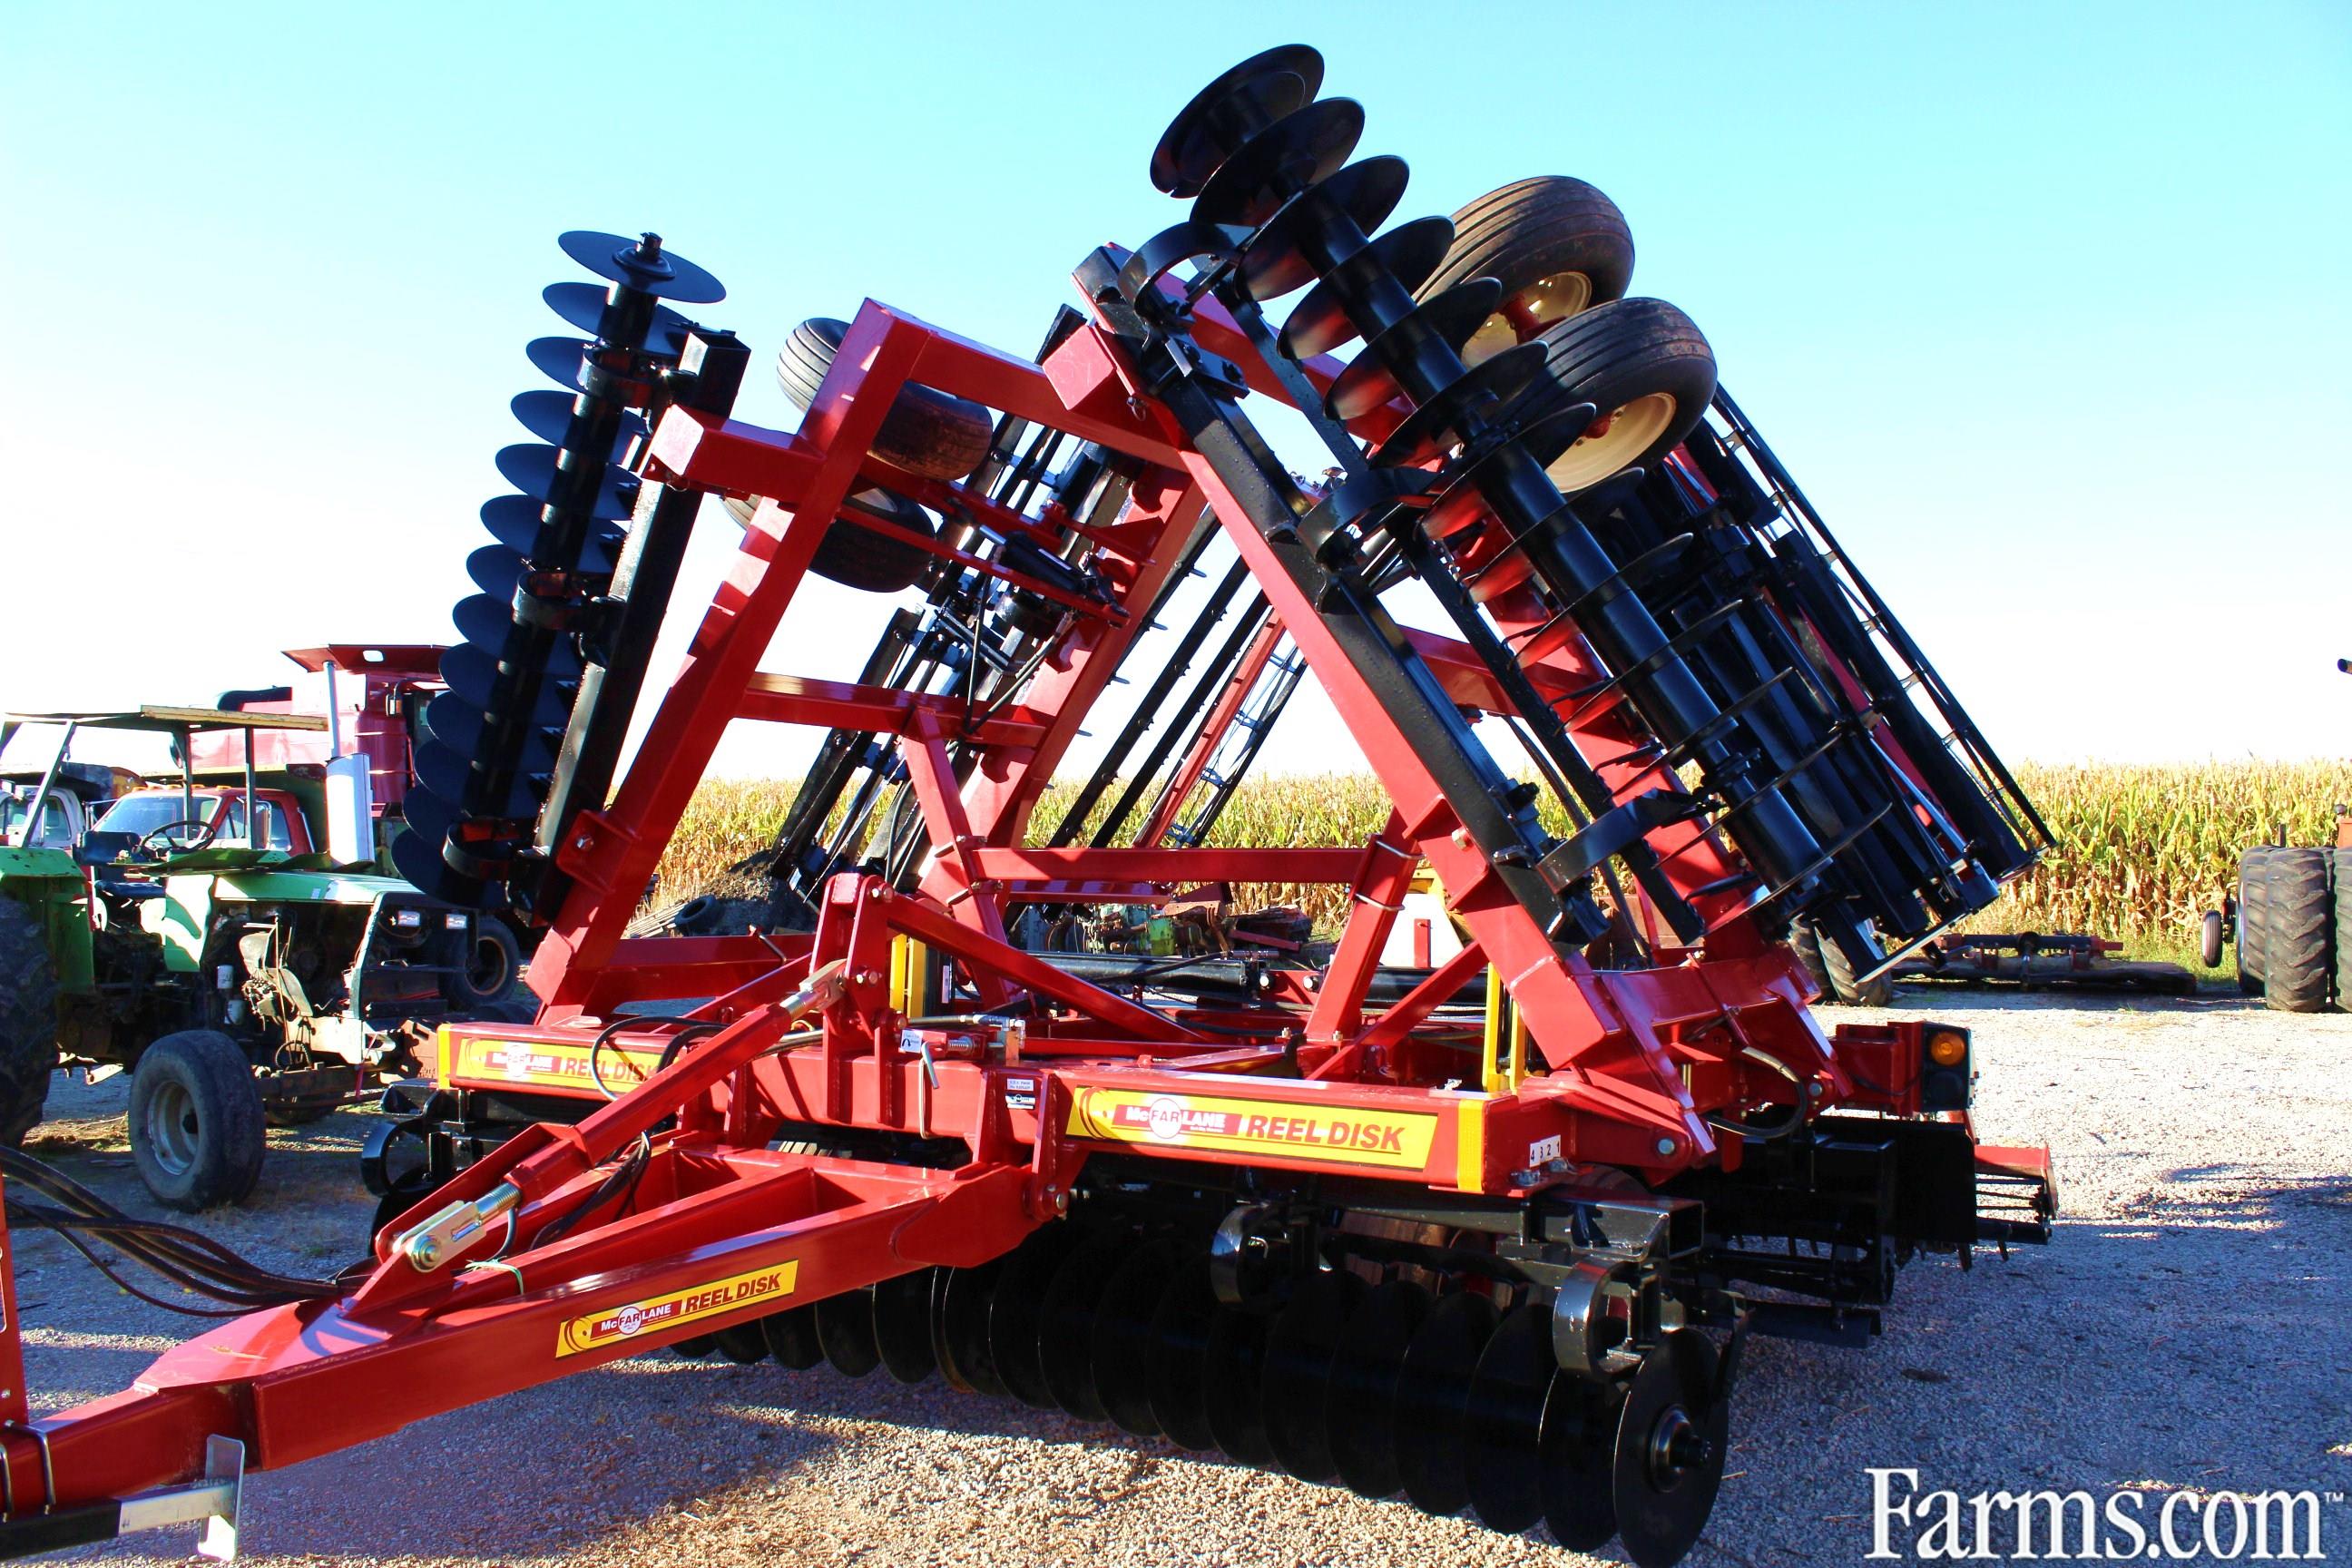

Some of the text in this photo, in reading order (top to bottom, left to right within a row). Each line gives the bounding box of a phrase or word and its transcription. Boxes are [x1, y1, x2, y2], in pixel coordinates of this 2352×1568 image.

[1125, 1105, 1405, 1151] McFARLANE REEL DISK
[601, 1272, 781, 1331] McFARLANE REEL DISK
